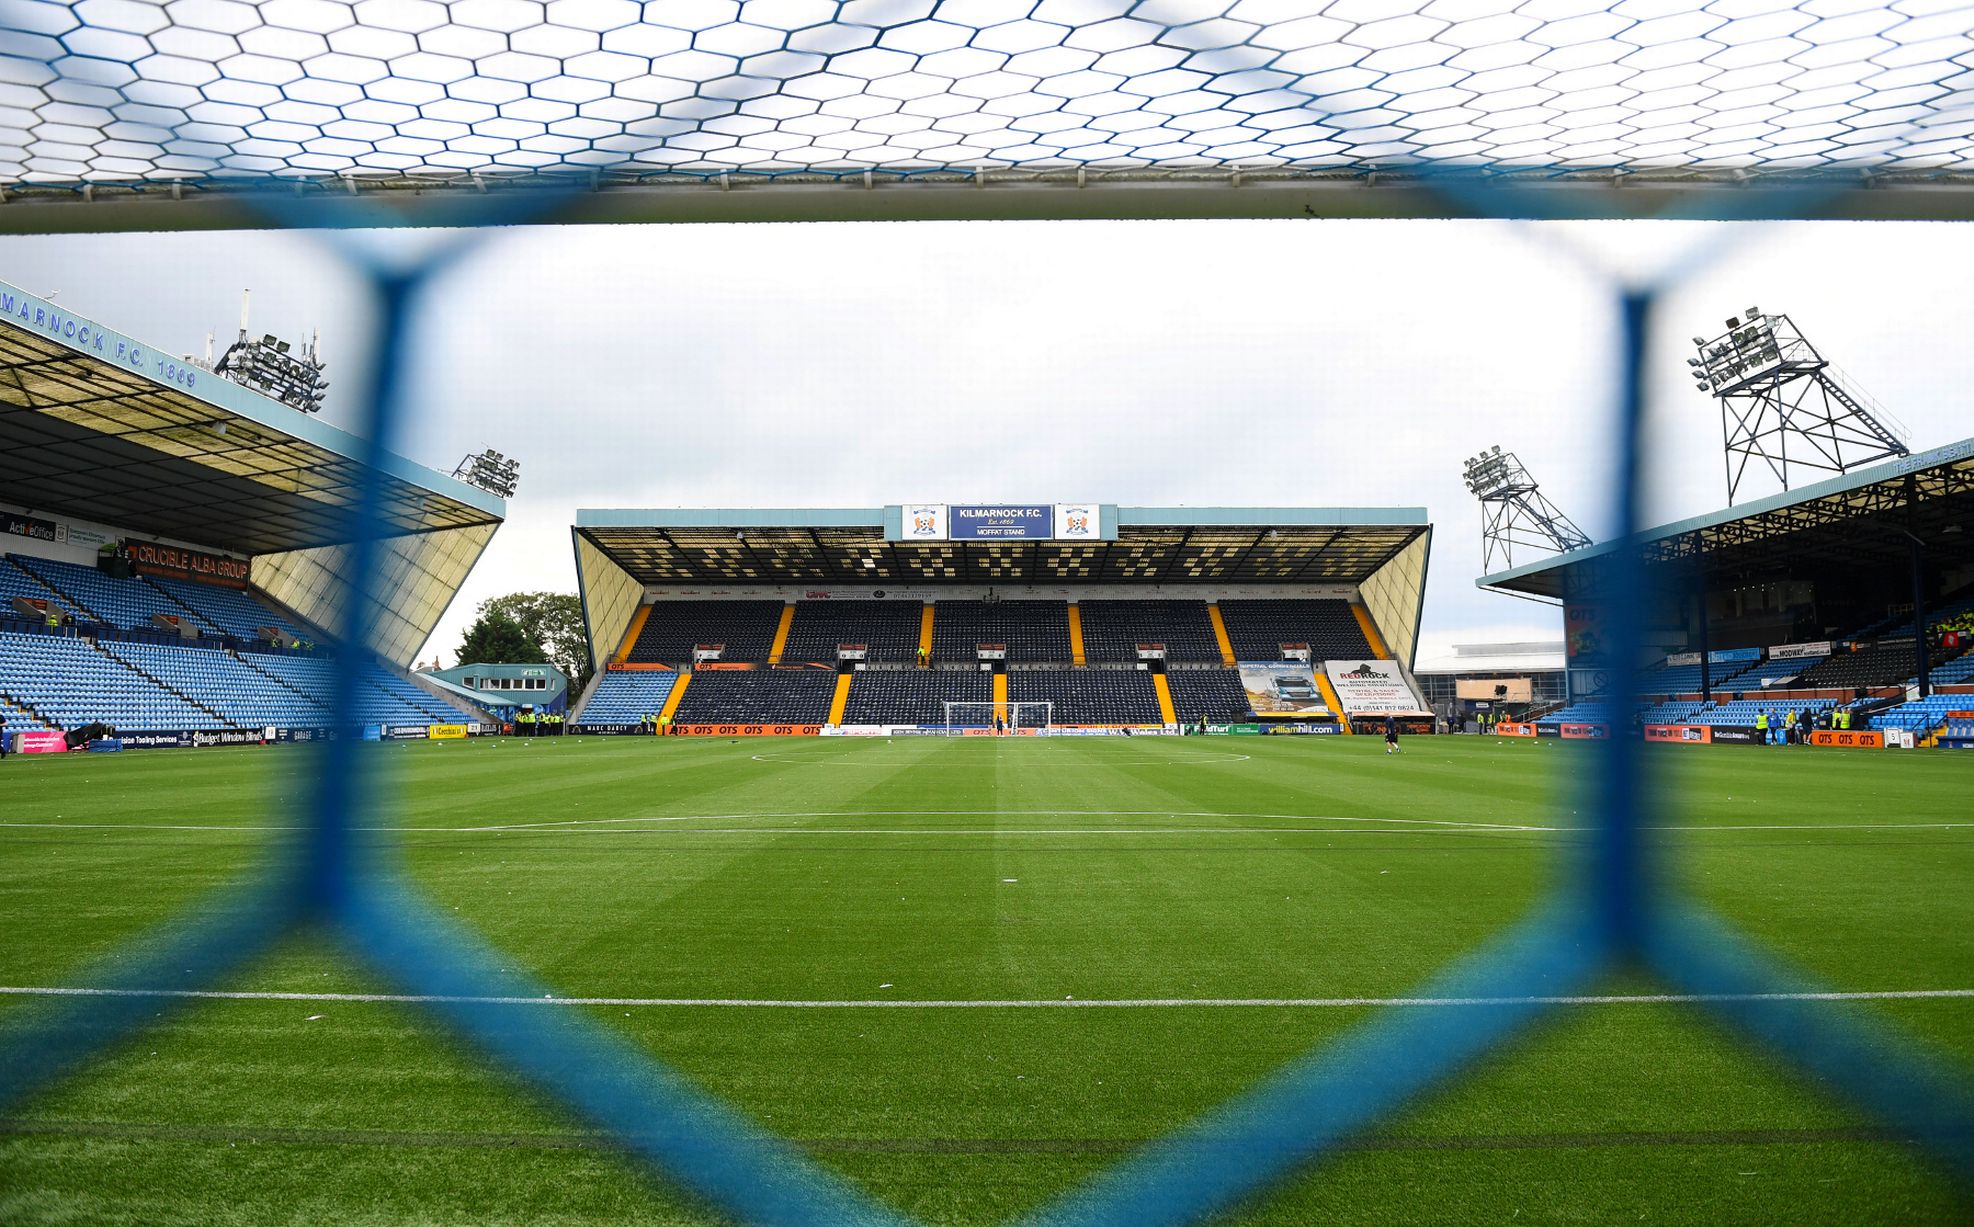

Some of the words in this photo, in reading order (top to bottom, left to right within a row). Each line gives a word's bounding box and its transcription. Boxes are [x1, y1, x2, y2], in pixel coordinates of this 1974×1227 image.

[960, 509, 1024, 518] KILMARNOCK
[1026, 510, 1042, 518] F.C.
[138, 545, 188, 570] CRUCIBLE
[191, 555, 216, 574] ALBA
[218, 560, 248, 579] GROUP
[694, 726, 713, 735] OTS
[719, 726, 738, 735] OTS
[745, 726, 763, 735] OTS
[774, 726, 793, 735] OTS
[1268, 725, 1332, 733] williamhill.com
[136, 735, 155, 745] Tooling
[156, 735, 177, 744] Services
[199, 733, 220, 745] Budget
[221, 733, 244, 742] Window
[246, 732, 263, 741] Blinds
[1818, 733, 1832, 744] OTS
[1838, 734, 1853, 745] OTS
[1860, 734, 1875, 745] OTS
